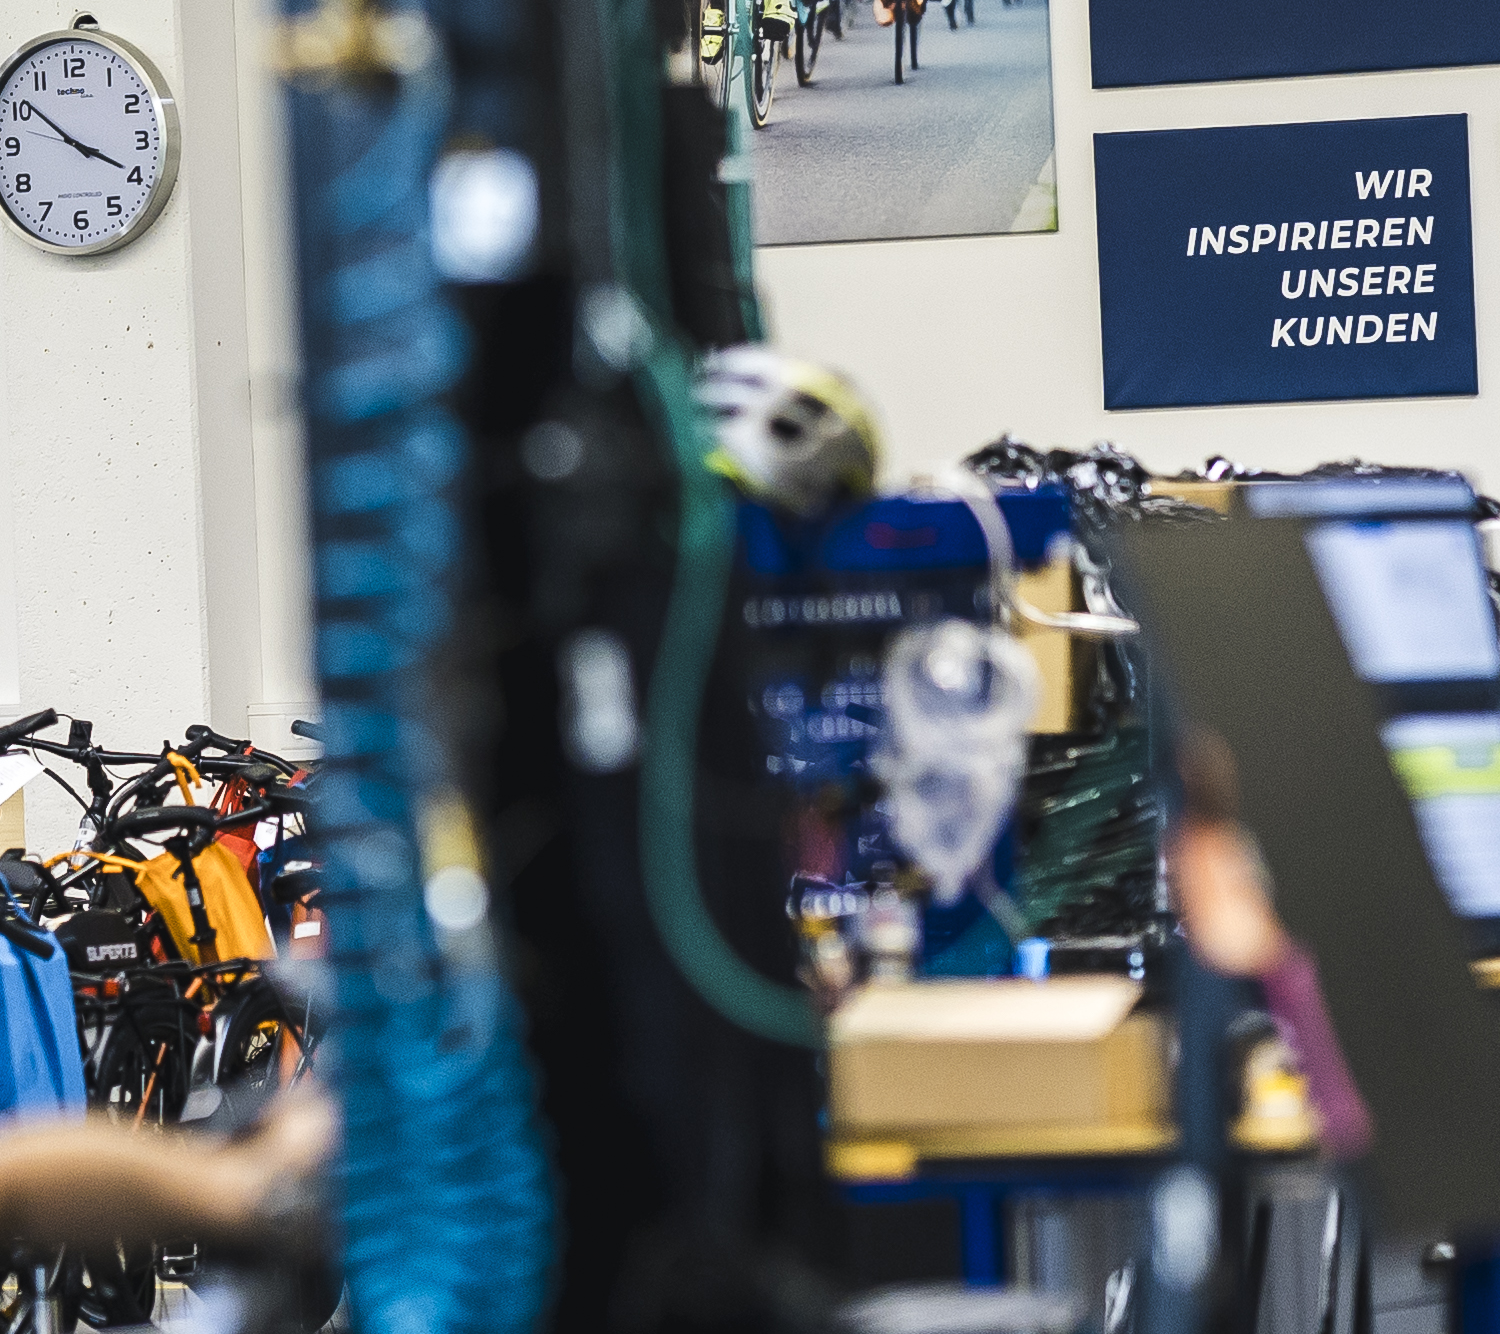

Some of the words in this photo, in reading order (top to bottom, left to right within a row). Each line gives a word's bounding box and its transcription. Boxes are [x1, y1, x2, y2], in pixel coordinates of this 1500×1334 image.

[63, 57, 86, 79] 12
[106, 67, 112, 88] 1
[34, 70, 47, 91] 11
[12, 100, 32, 121] 10
[124, 94, 140, 114] 2
[4, 136, 21, 157] 9
[134, 130, 150, 151] 3
[15, 173, 31, 193] 8
[126, 165, 143, 186] 4
[1354, 168, 1433, 200] WIR
[38, 201, 53, 222] 7
[106, 195, 122, 216] 5
[73, 210, 89, 231] 6
[1186, 216, 1434, 257] INSPIRIEREN
[1281, 263, 1437, 299] UNSERE
[1270, 311, 1438, 348] KUNDEN
